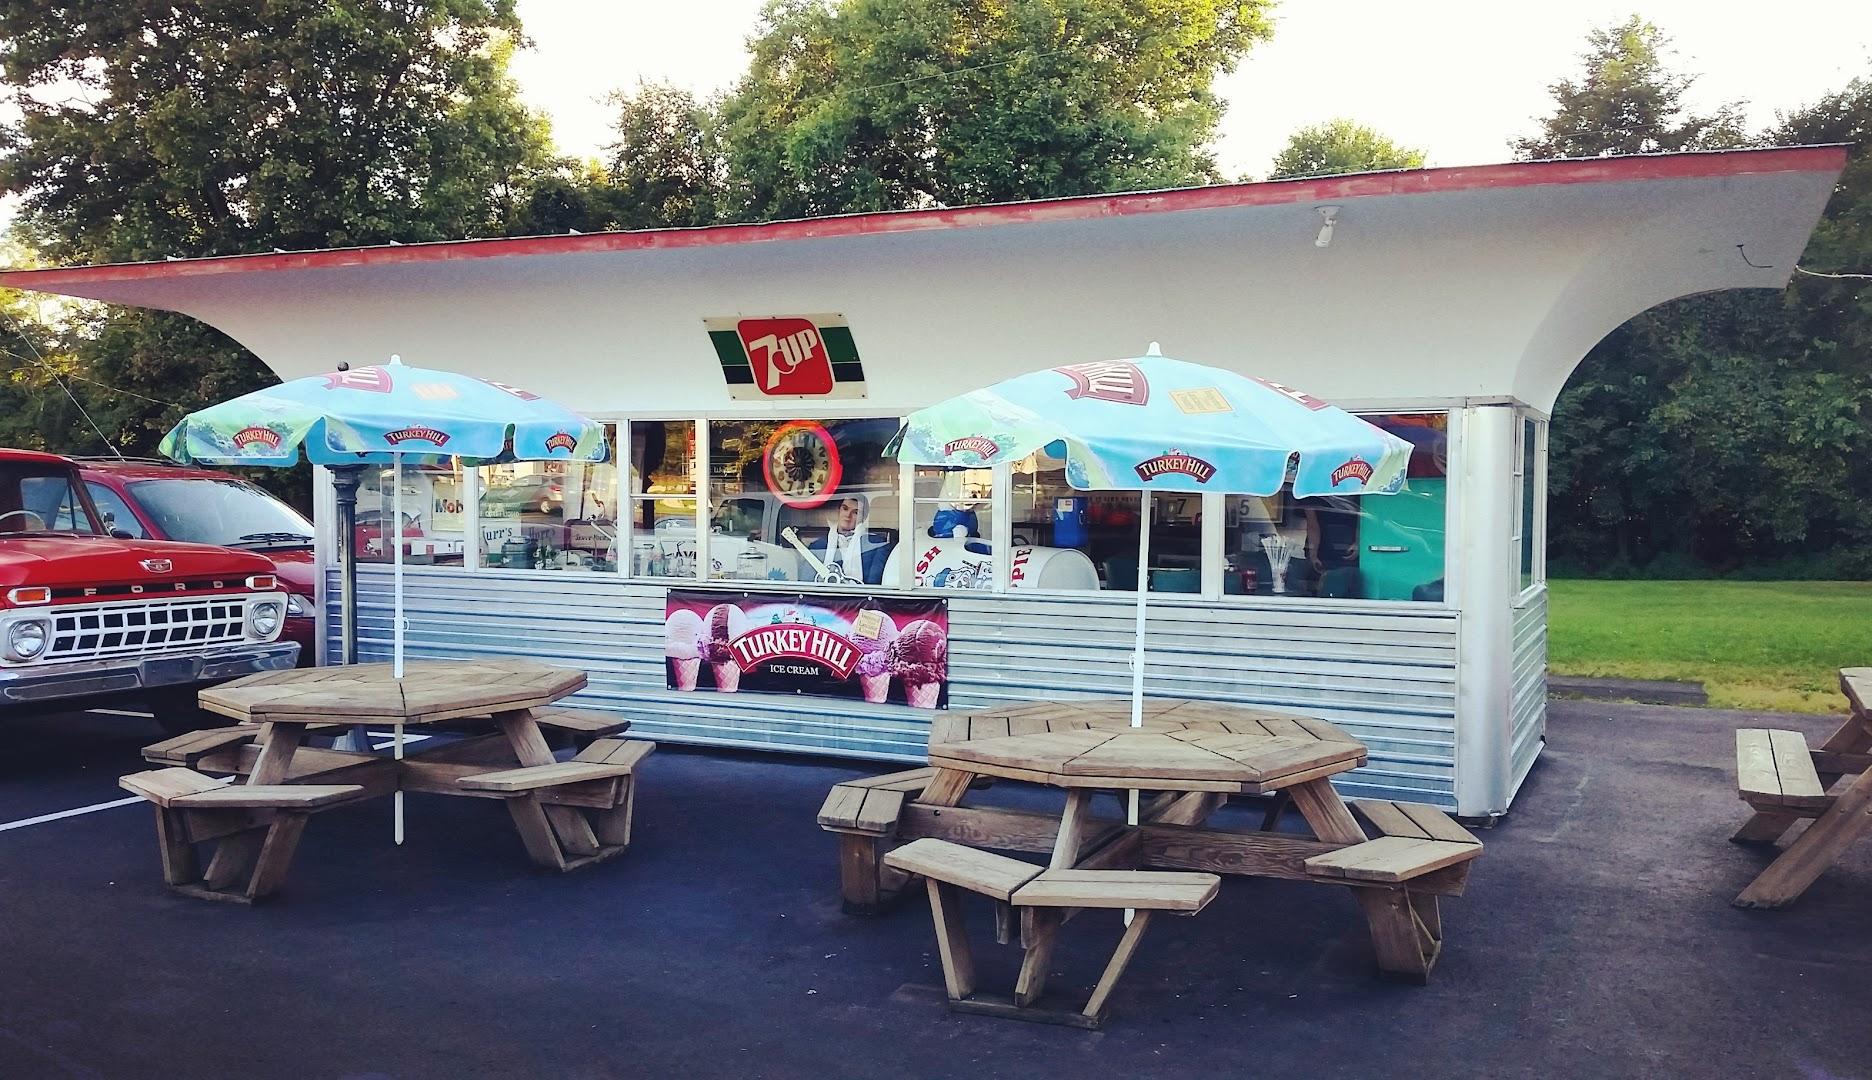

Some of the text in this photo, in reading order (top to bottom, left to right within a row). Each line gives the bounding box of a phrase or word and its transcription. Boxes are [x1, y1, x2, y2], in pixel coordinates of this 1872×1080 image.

[749, 328, 818, 391] 7UP
[234, 430, 280, 448] TURKEY HILL
[388, 429, 446, 443] TURKEY HILL
[948, 439, 997, 457] TURKEY HILL
[1139, 458, 1210, 479] TURKEY HILL
[1333, 463, 1371, 481] TURKEY HILL
[484, 527, 513, 541] urr's
[1011, 548, 1033, 586] PIE
[84, 582, 223, 595] FORD
[732, 629, 852, 670] TURKEY HILL
[770, 664, 819, 676] ICE CREAM
